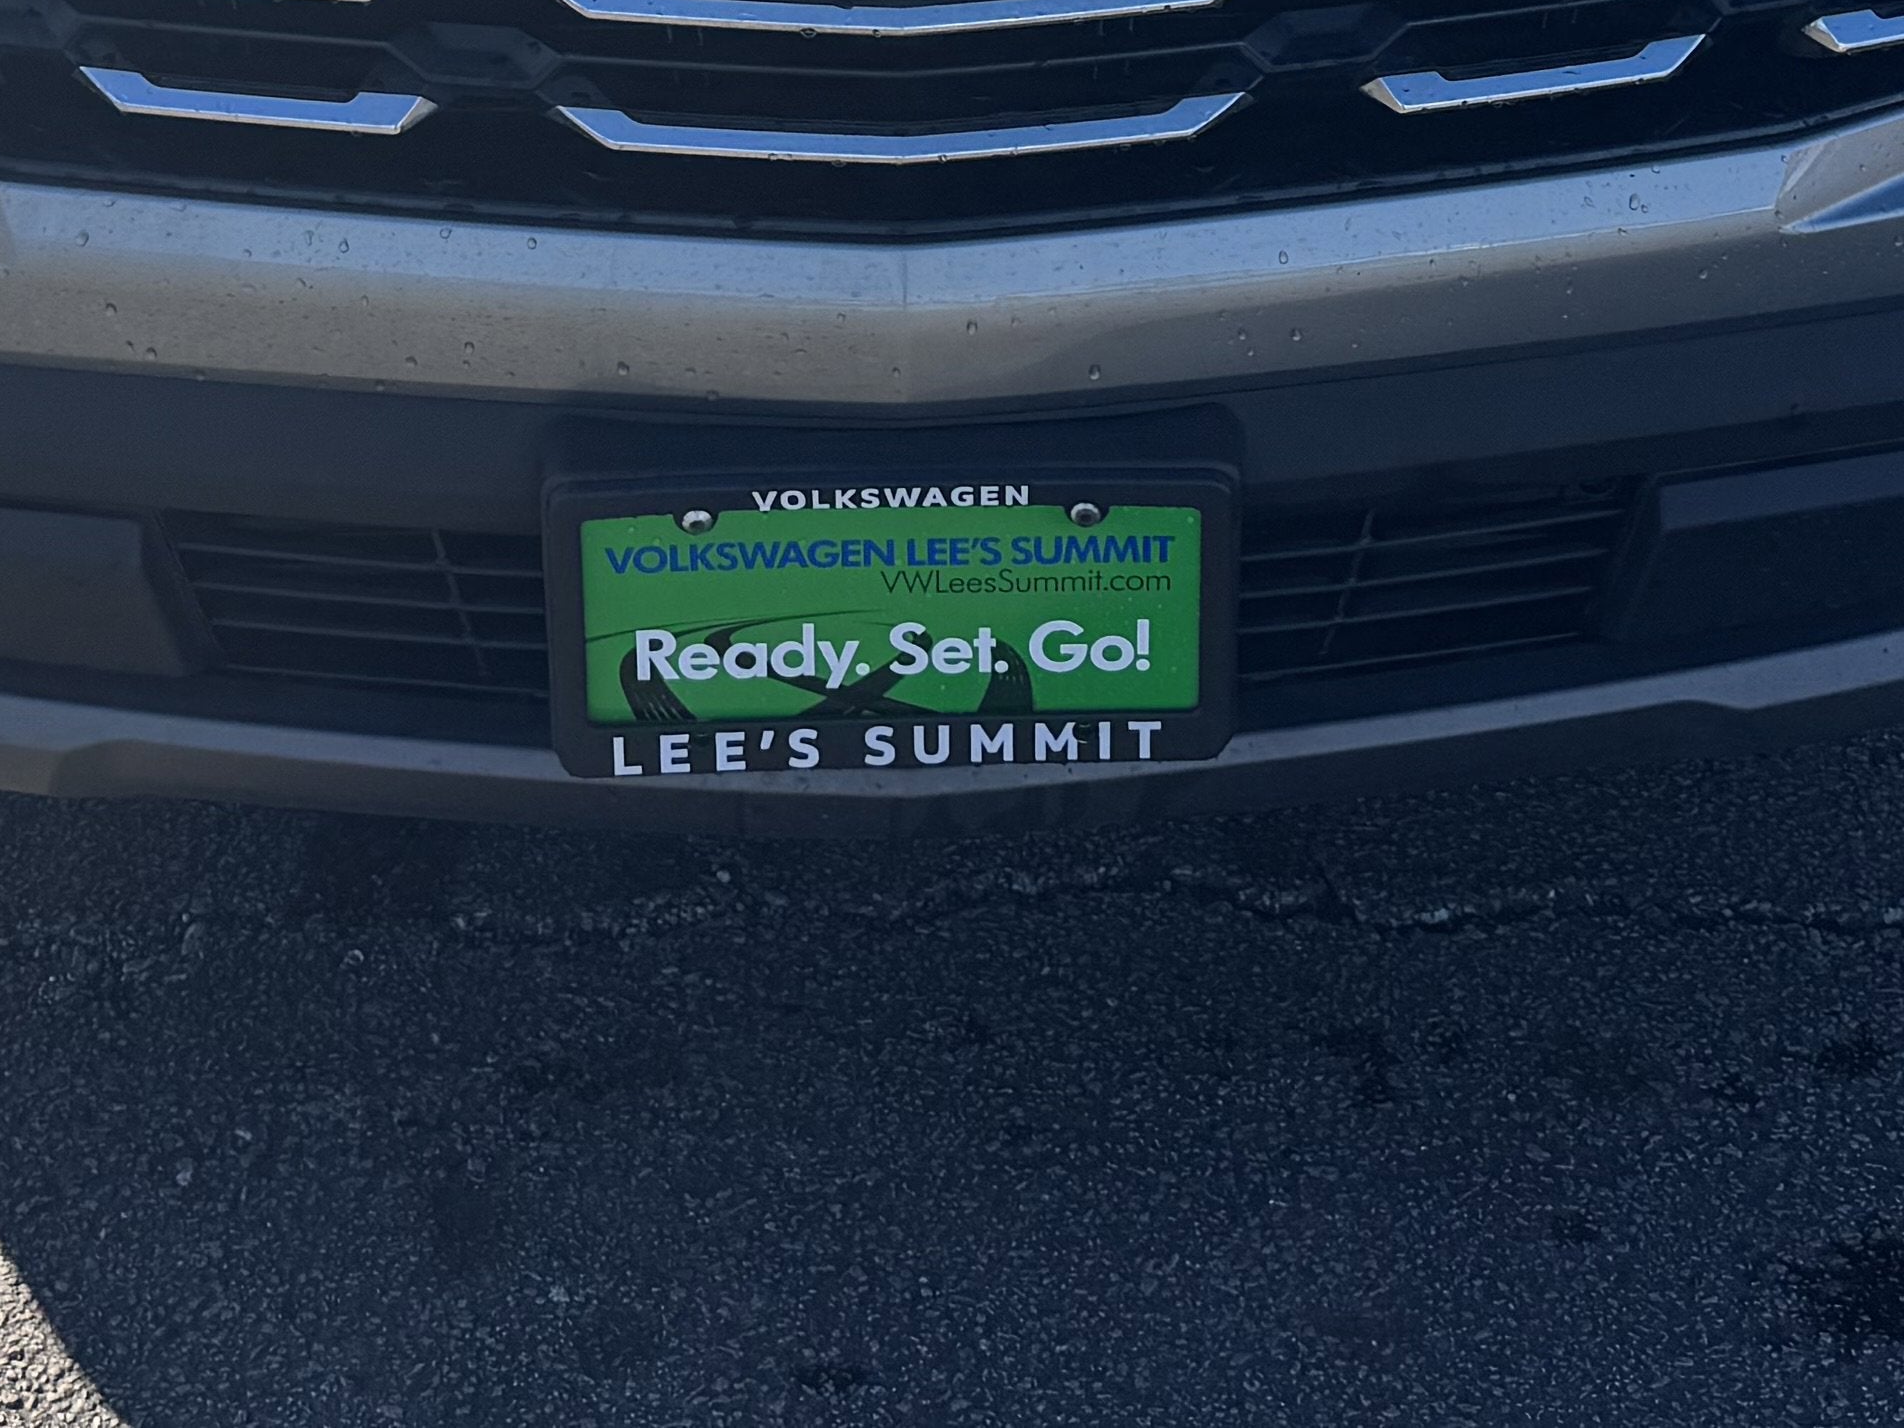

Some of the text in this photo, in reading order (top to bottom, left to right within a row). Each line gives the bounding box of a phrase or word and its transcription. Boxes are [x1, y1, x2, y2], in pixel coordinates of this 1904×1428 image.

[752, 485, 1030, 512] VOLKSWAGEN
[604, 535, 1176, 574] VOLKSWAGEN LEE'S SUMMIT
[880, 568, 1172, 594] VWLeesSummit.com
[635, 618, 1151, 689] Ready. Set. Go!
[612, 720, 1163, 776] LEE'S SUMMIT
